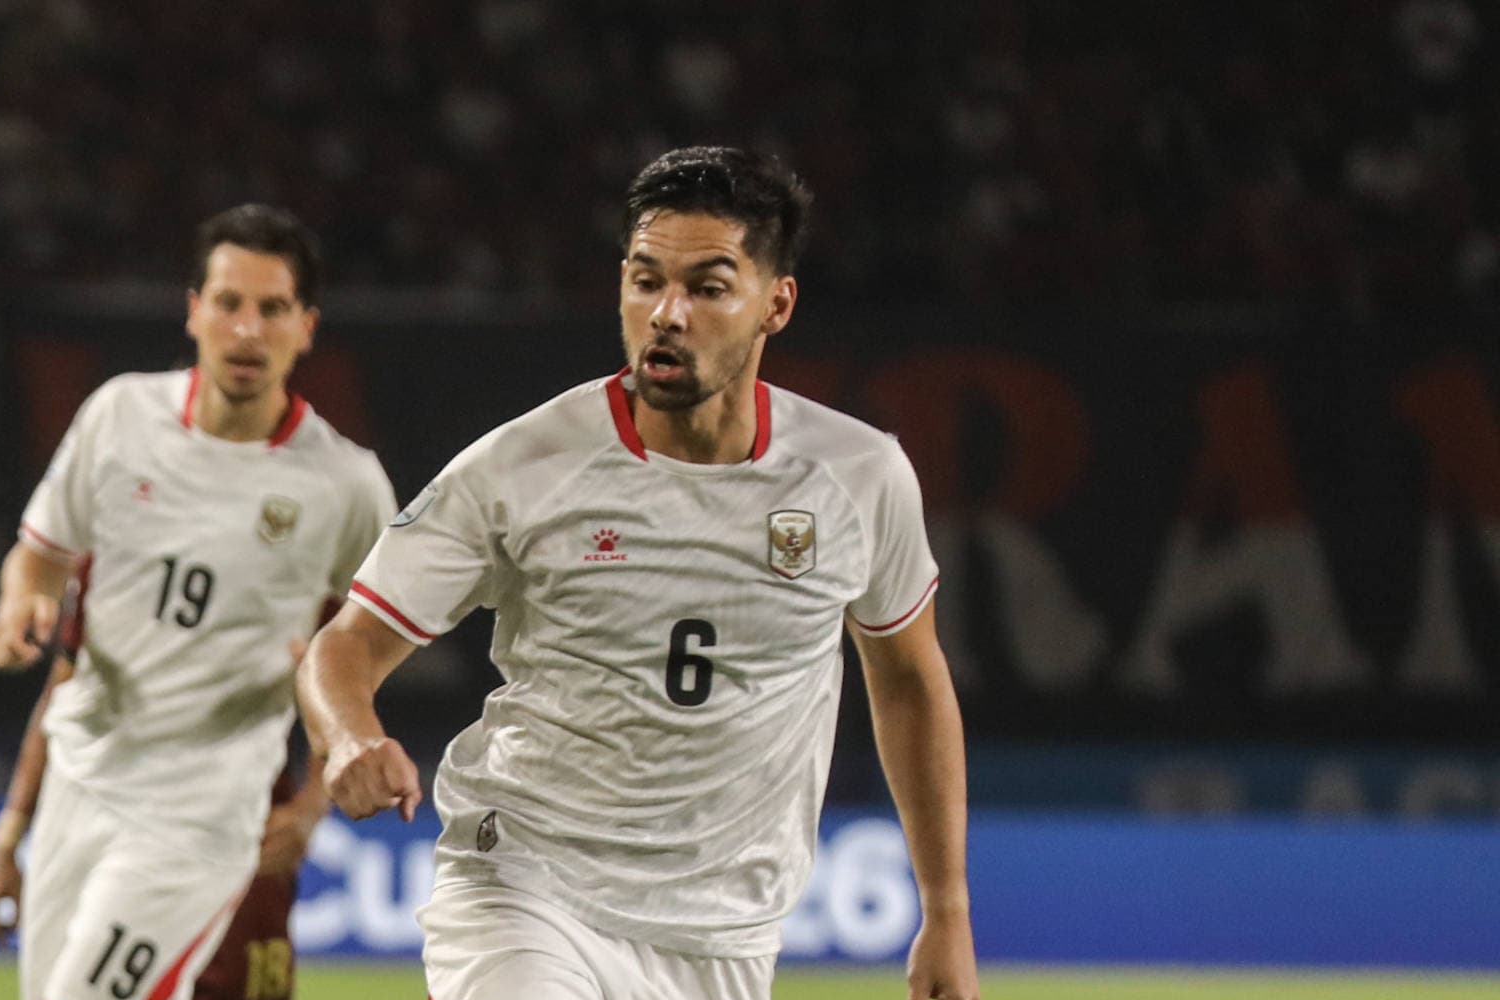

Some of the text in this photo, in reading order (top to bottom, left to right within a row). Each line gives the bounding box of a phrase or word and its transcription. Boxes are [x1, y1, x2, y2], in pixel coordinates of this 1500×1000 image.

[155, 557, 215, 629] 19
[583, 553, 628, 561] KELME
[665, 618, 717, 707] 6
[288, 817, 436, 950] Cu
[87, 922, 157, 1000] 19
